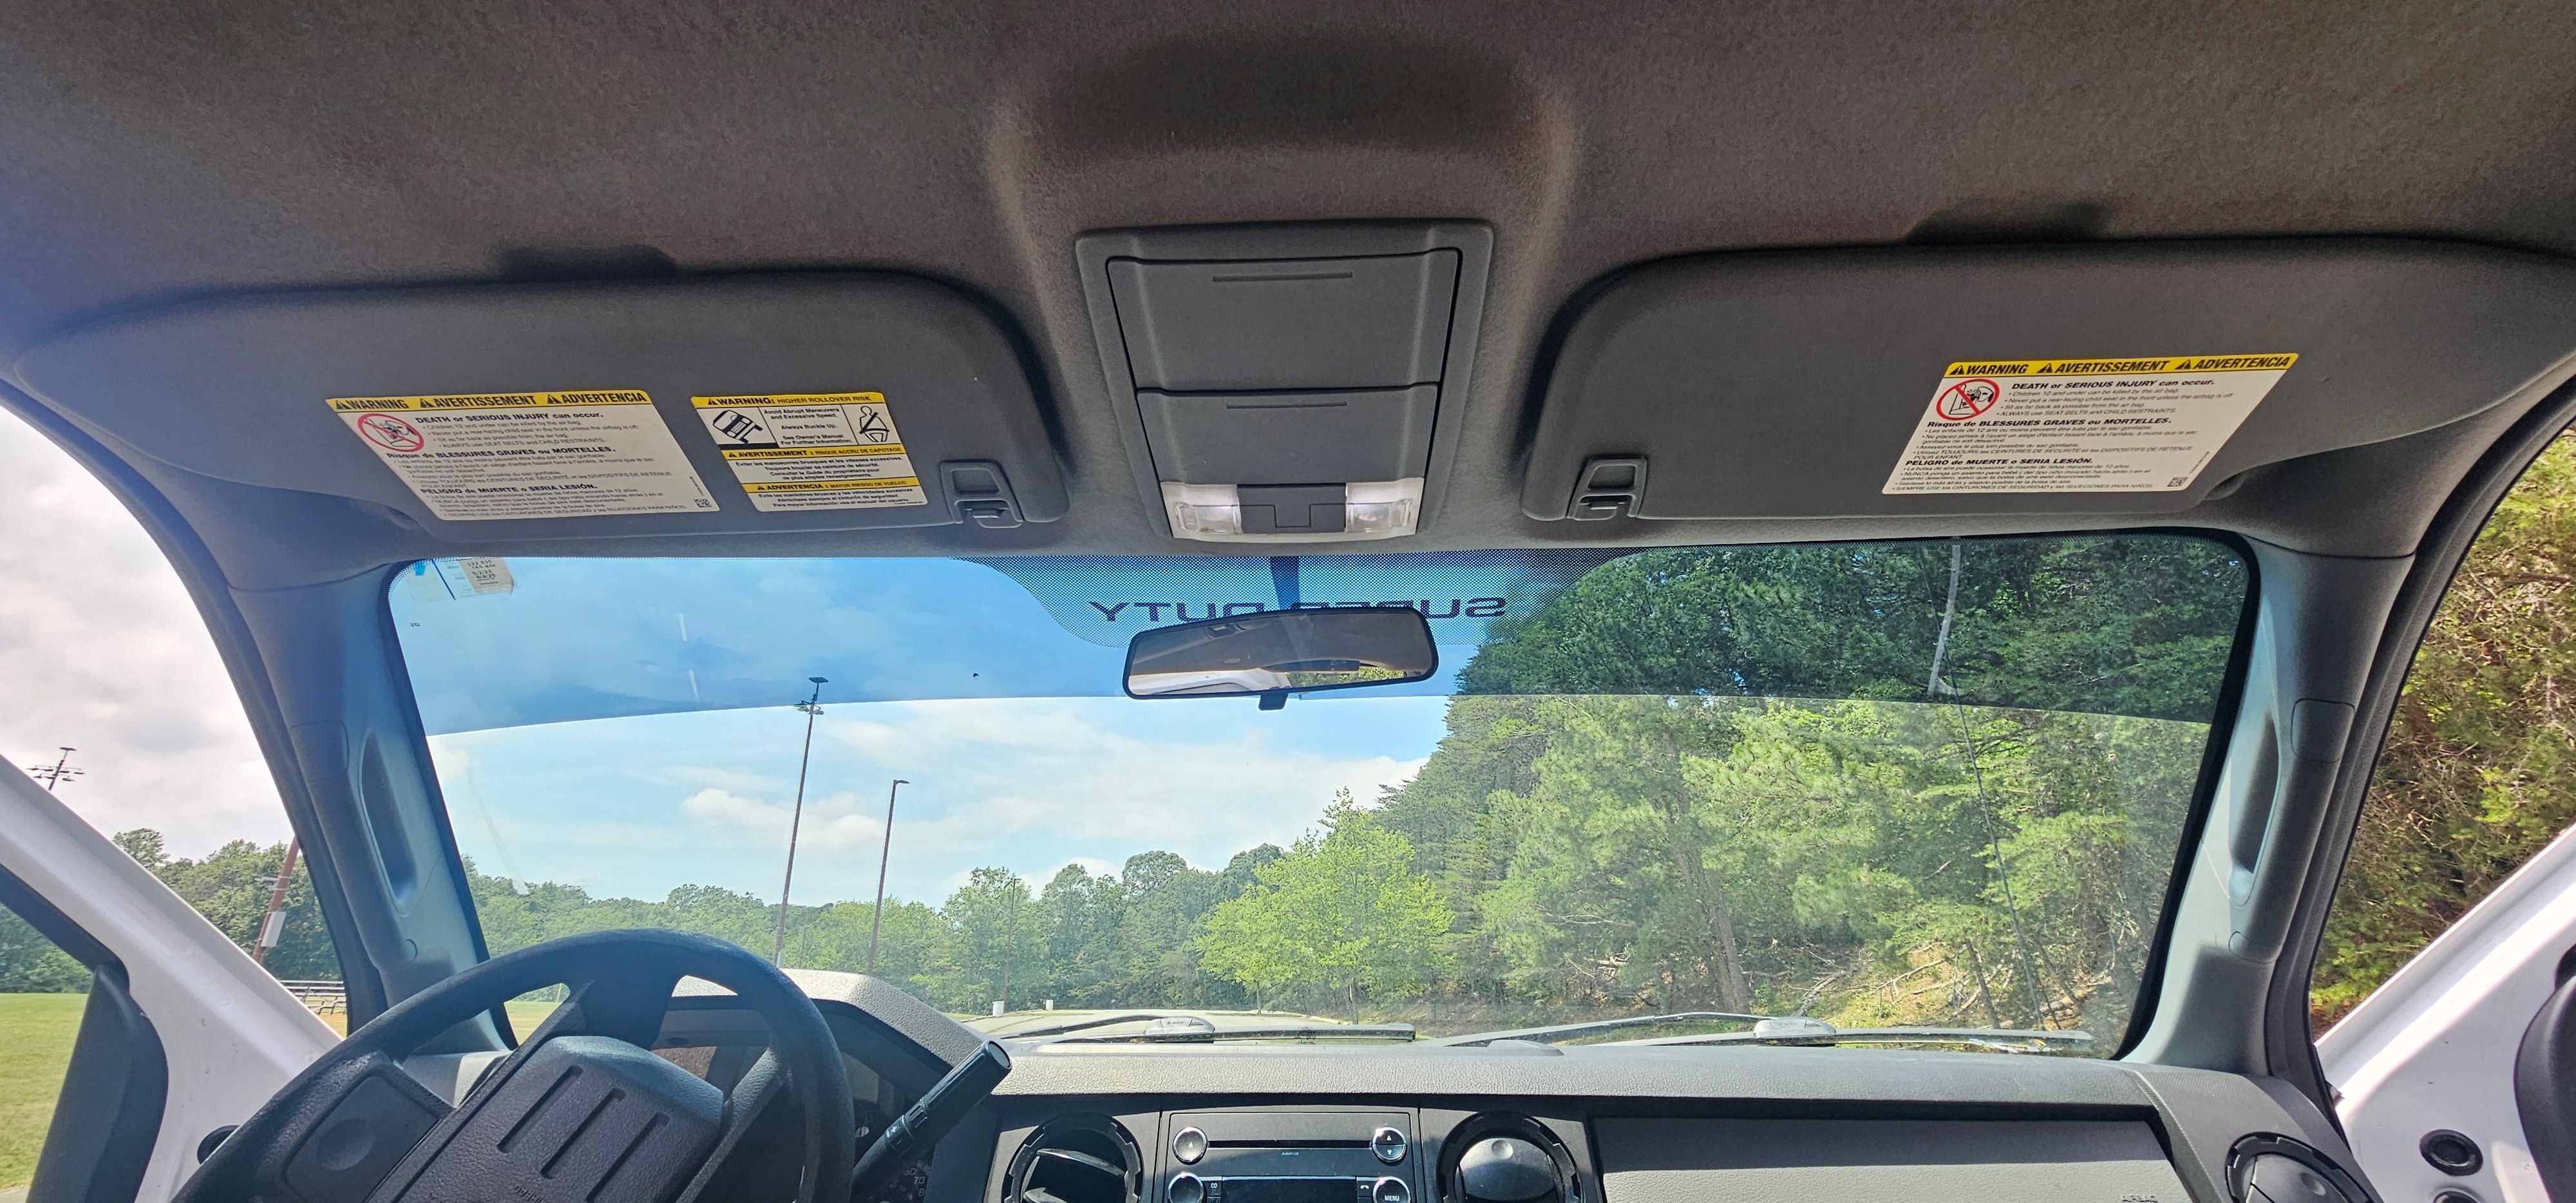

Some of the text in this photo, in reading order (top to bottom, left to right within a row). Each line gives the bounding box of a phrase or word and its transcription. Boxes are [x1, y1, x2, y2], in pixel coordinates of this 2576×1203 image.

[1965, 356, 2291, 375] WARNING AVERTISSEMENT ADVERTENCIA
[345, 392, 647, 410] WARNING AVERTISSEMENT ADVERTENCIA
[914, 1176, 925, 1184] 70
